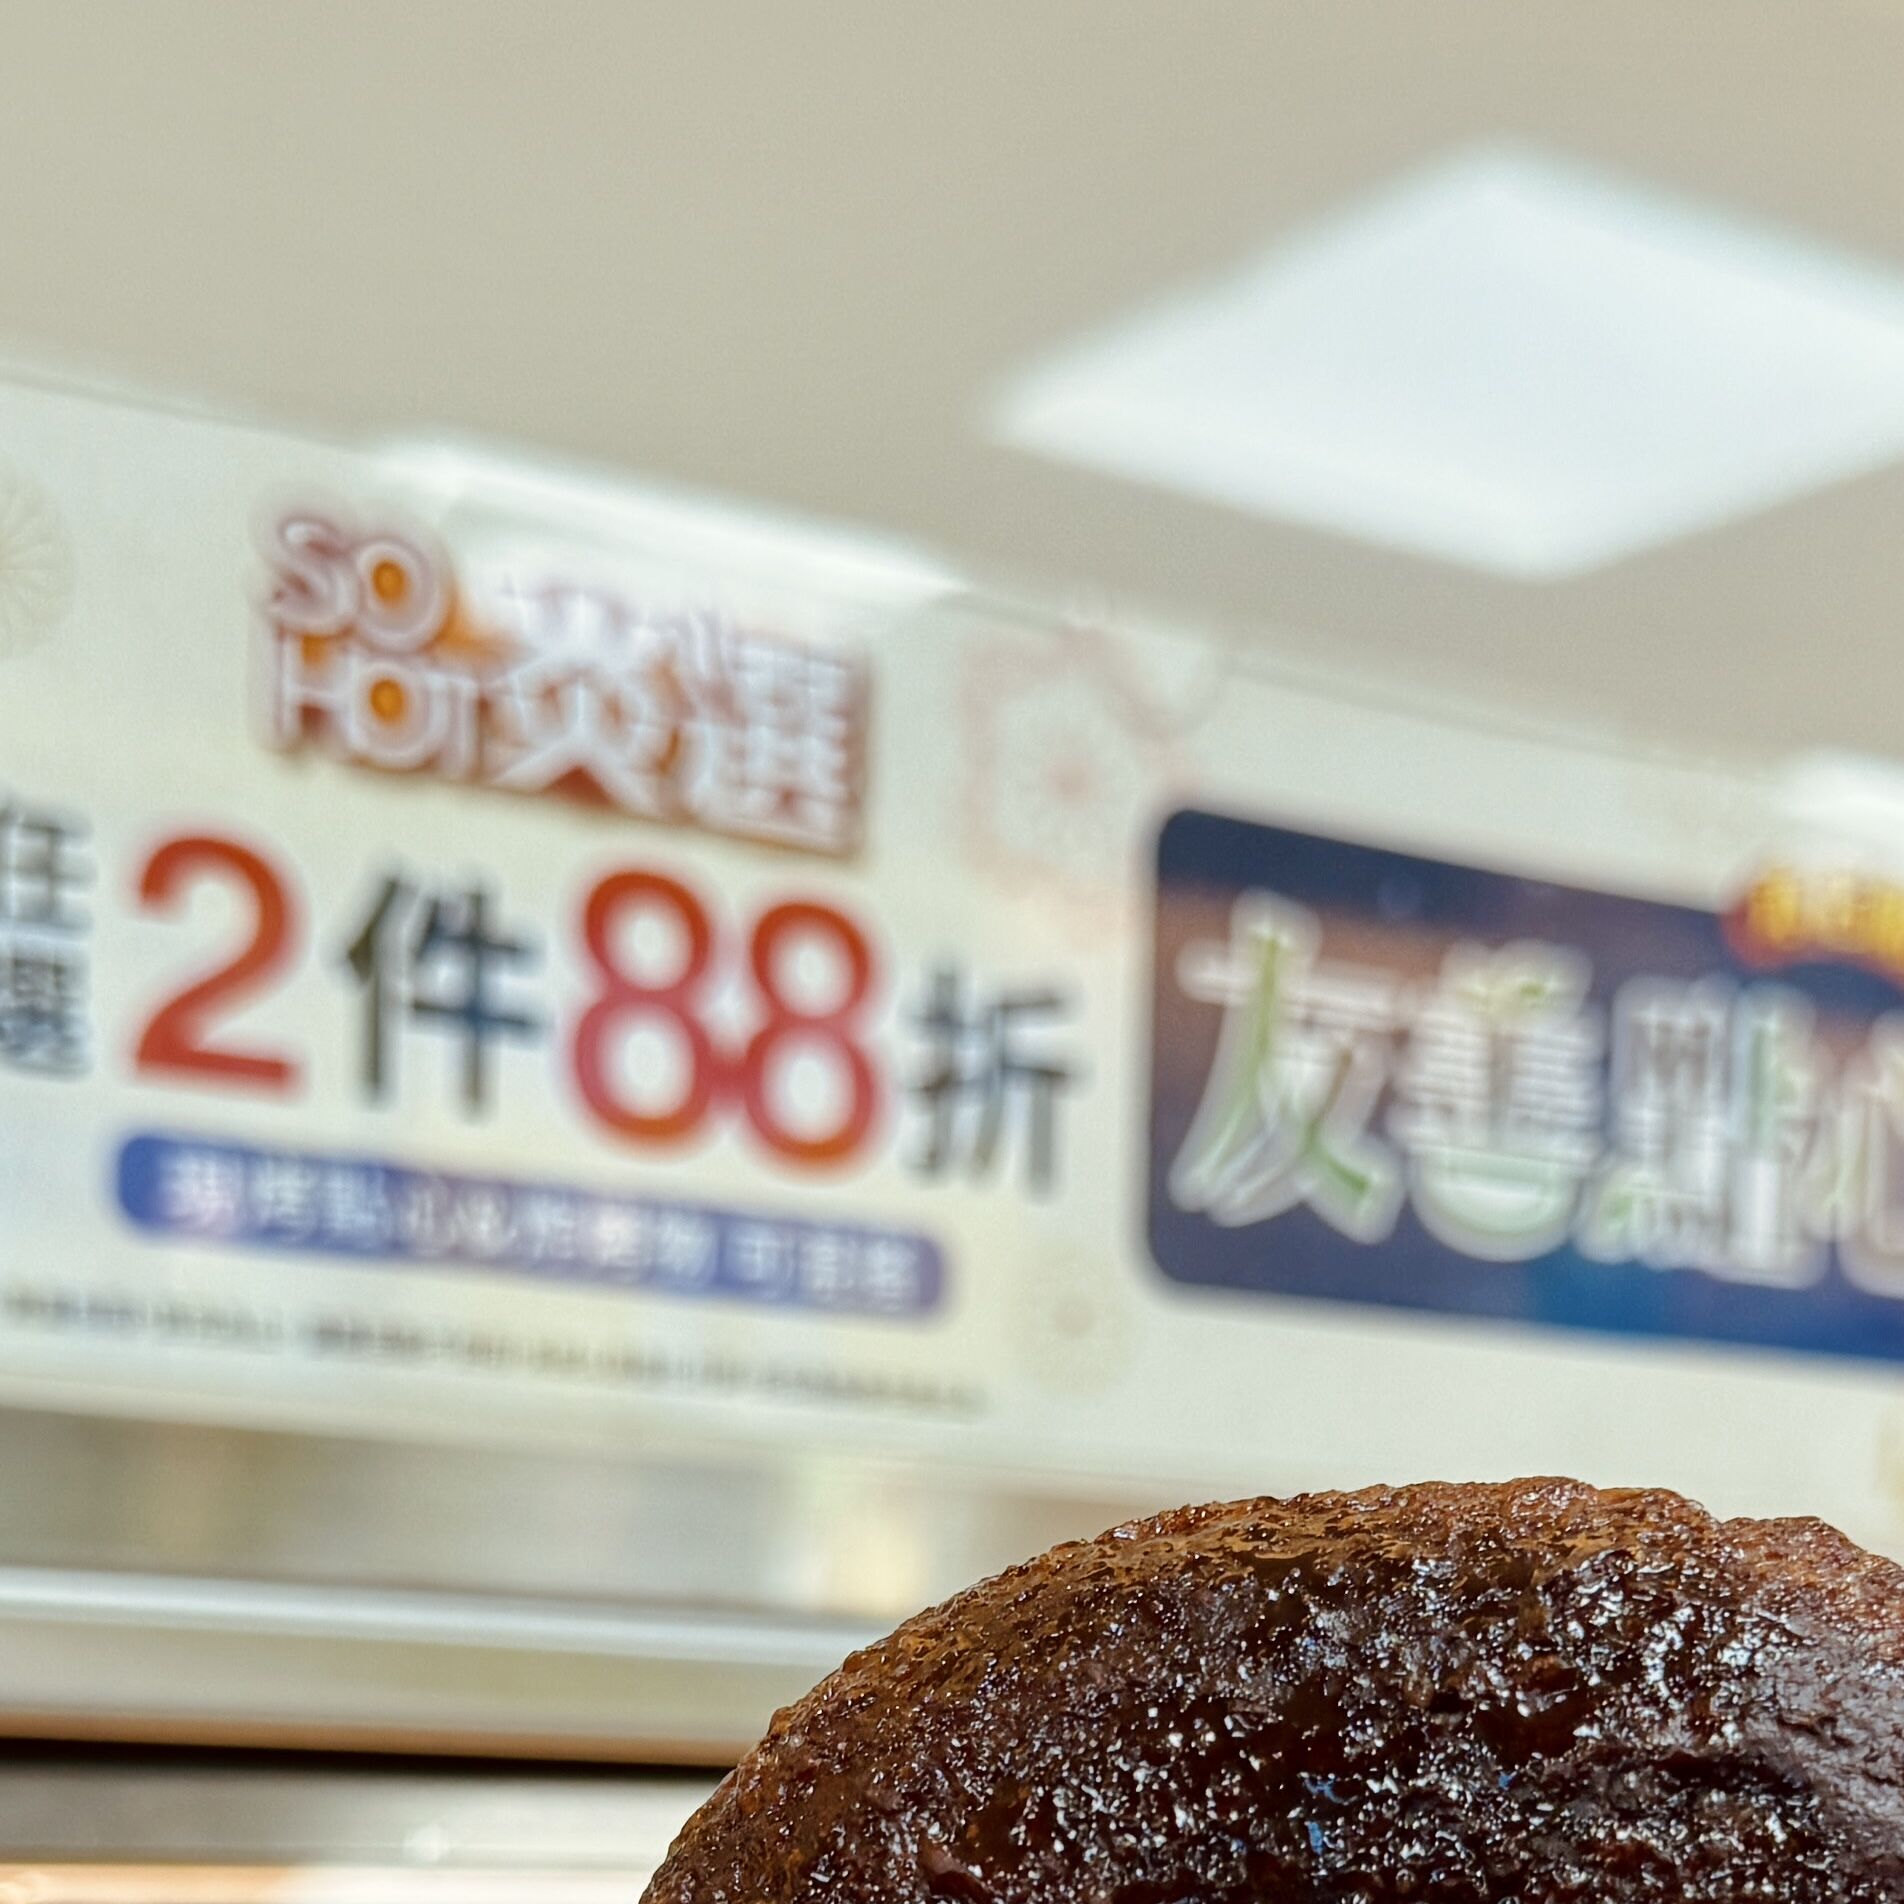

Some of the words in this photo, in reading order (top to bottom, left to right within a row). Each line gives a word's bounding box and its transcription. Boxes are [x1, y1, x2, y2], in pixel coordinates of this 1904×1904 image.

[268, 516, 441, 652] SO
[274, 640, 486, 782] HOT
[130, 834, 1080, 1192] 2件88折
